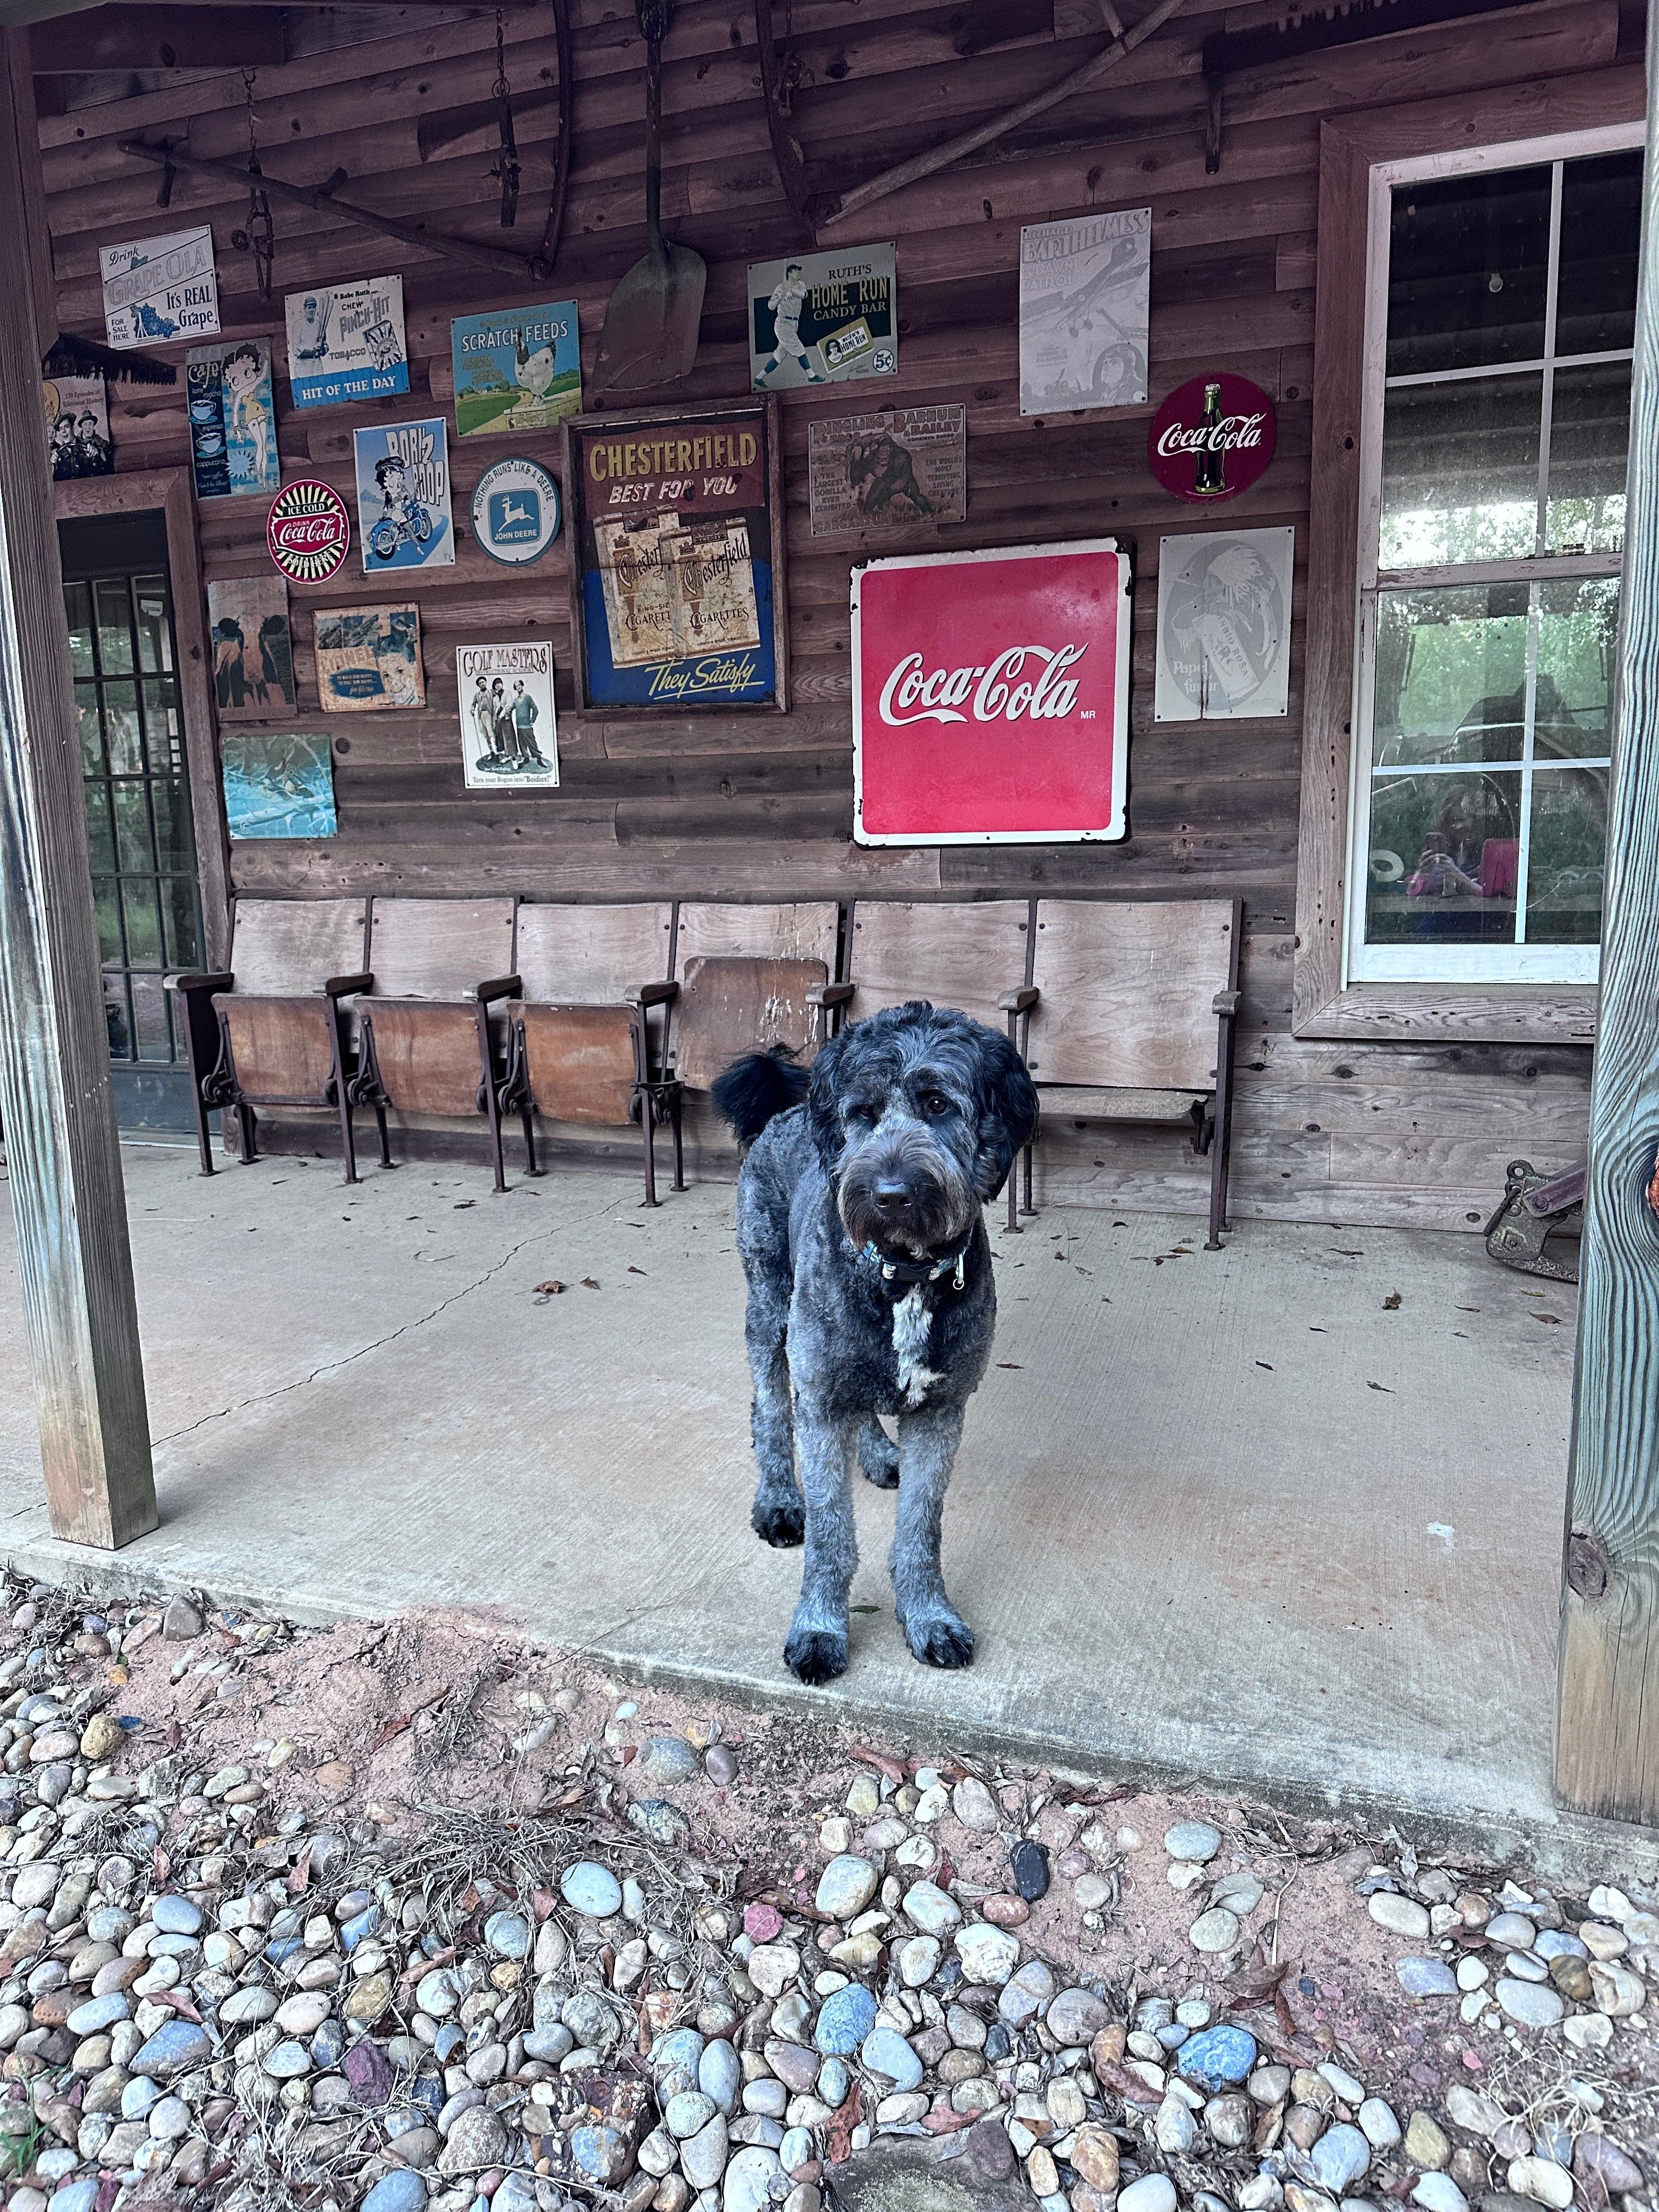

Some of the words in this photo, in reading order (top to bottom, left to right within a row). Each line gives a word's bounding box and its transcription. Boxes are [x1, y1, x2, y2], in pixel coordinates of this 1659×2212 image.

[109, 246, 139, 266] Drink
[109, 264, 165, 305] GRAPE
[166, 246, 206, 279] OLA
[828, 264, 872, 280] RUTH'S
[166, 292, 181, 309] It's
[184, 285, 212, 307] REAL
[811, 281, 848, 309] HOME
[860, 276, 887, 302] RUN
[342, 301, 363, 311] CHEW
[813, 304, 859, 321] CANDY
[861, 301, 887, 314] BAR
[179, 309, 213, 329] Grape
[114, 332, 129, 341] HERE
[462, 328, 519, 352] SCRATCH
[526, 320, 568, 342] FEEDS
[856, 334, 866, 345] RUN
[329, 348, 366, 360] TOBACCO
[302, 387, 323, 400] HIT
[326, 385, 341, 396] OF
[343, 380, 369, 393] THE
[373, 376, 396, 389] DAY
[814, 415, 885, 444] RINGLING
[894, 408, 962, 433] BARNUM
[911, 420, 961, 436] BAILEY
[1158, 412, 1267, 456] Coca-Cola
[590, 433, 757, 482] CHESTERFIELD
[475, 475, 494, 508] NOTHING
[493, 463, 511, 479] RUNS
[514, 462, 531, 474] LIKE
[531, 470, 537, 479] A
[537, 475, 554, 502] DEERE
[608, 482, 654, 504] BEST
[703, 474, 739, 496] YOU
[288, 505, 302, 515] ICE
[302, 503, 325, 512] COLD
[279, 517, 337, 545] Coca-Cola
[494, 532, 513, 541] JOHN
[514, 529, 537, 538] DEERE
[289, 555, 310, 568] SOLD
[684, 533, 747, 596] Chesterfield
[690, 607, 750, 630] CIGARETTES
[464, 650, 493, 677] GOLF
[496, 647, 547, 674] MASTERS
[1173, 659, 1208, 676] Papel
[645, 659, 691, 698] They
[690, 653, 756, 693] Satisfy
[879, 641, 1089, 727] Coca-Cola
[1080, 710, 1096, 720] MR
